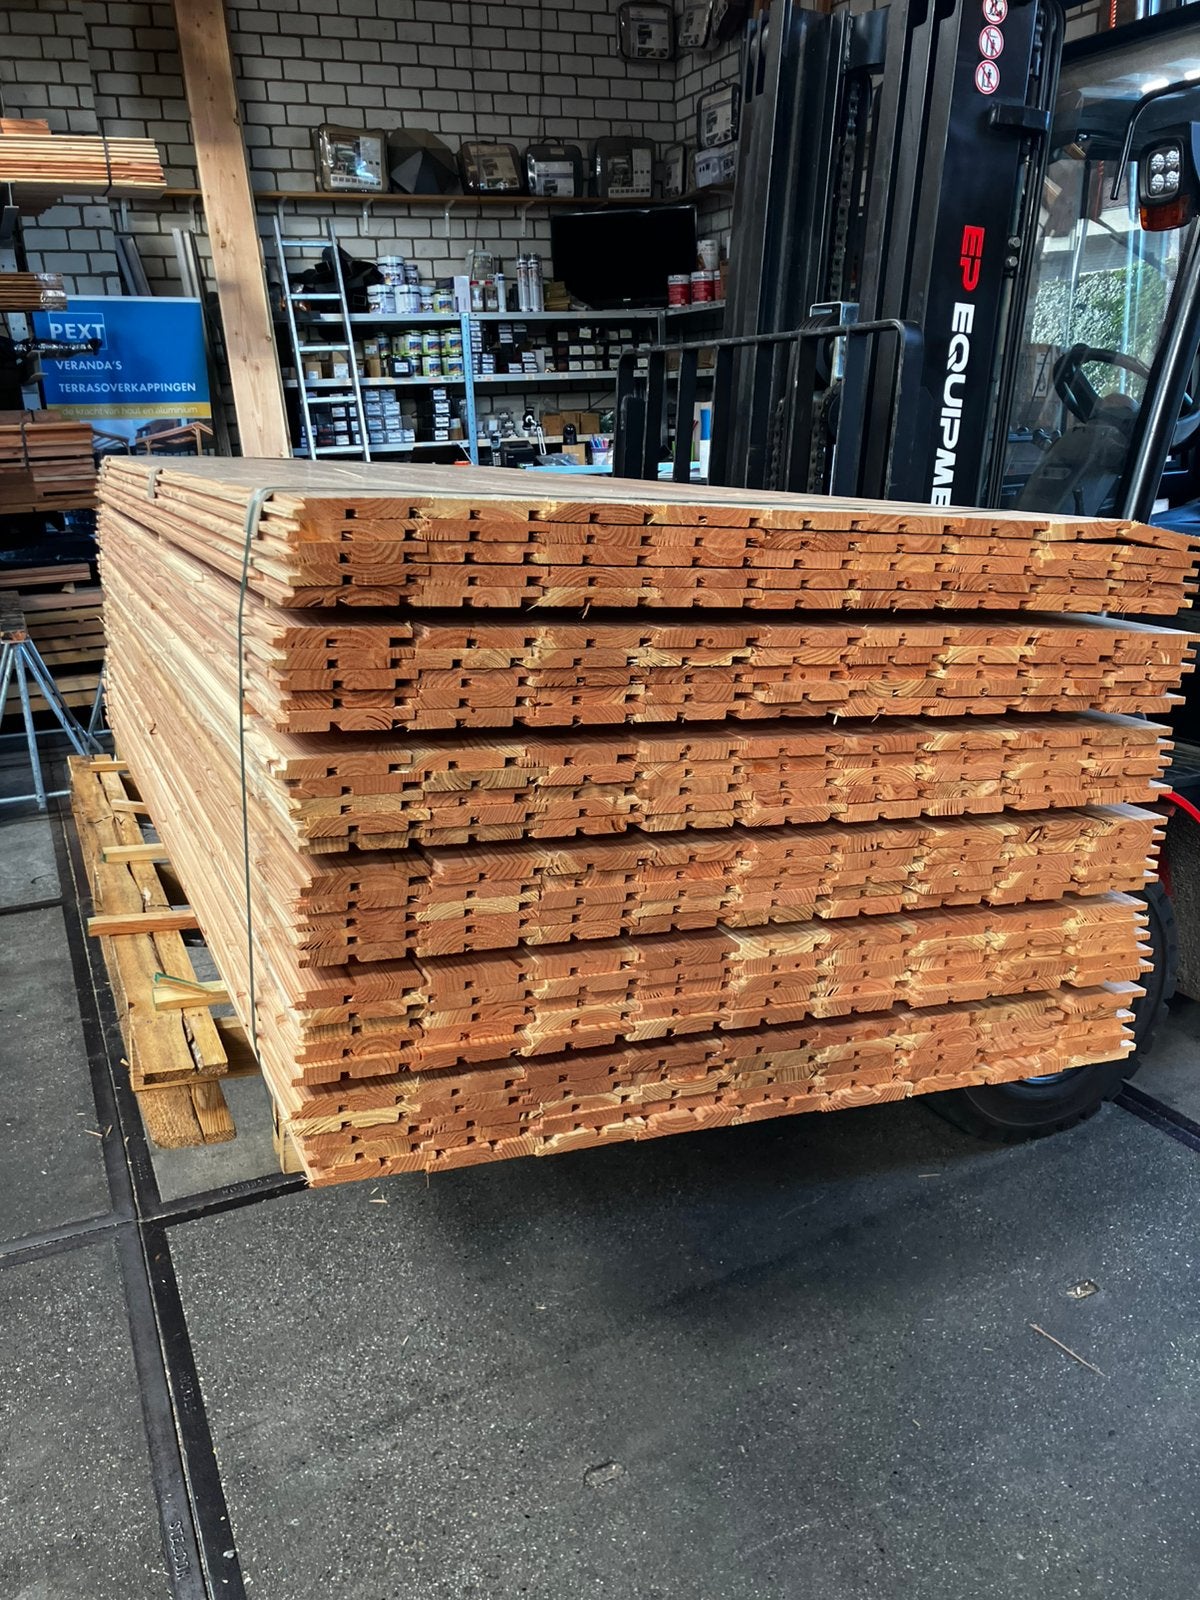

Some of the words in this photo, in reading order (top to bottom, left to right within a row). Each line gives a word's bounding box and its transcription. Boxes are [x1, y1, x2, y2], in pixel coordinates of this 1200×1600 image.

[960, 224, 985, 291] EP
[50, 323, 105, 339] PEXT
[55, 360, 122, 370] VERANDA'S
[58, 382, 197, 393] TERRASOVERKAPPINGEN
[76, 406, 103, 416] kracht
[103, 407, 120, 416] van
[122, 406, 141, 416] hout
[155, 405, 198, 415] aluminium
